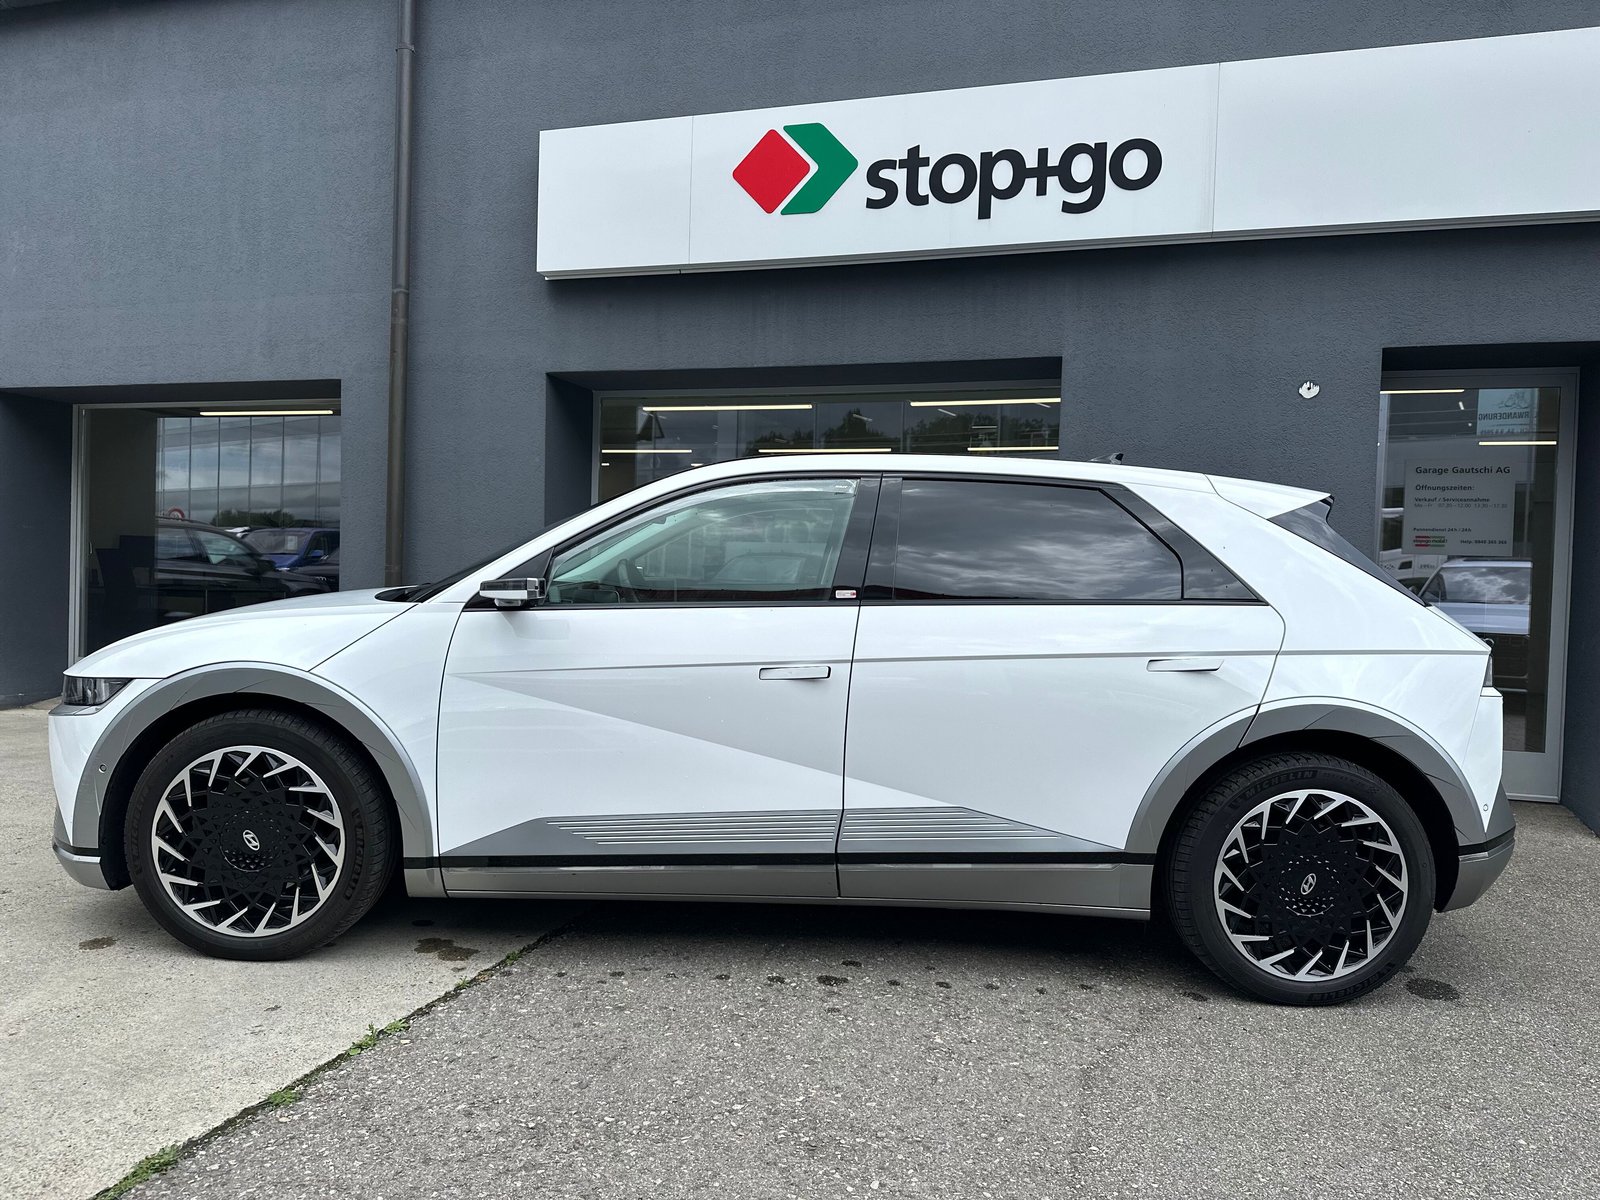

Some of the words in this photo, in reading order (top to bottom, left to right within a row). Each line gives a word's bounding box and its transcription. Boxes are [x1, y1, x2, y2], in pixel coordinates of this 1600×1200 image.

[865, 138, 1162, 219] stop+go
[1415, 466, 1449, 475] Garage
[1451, 465, 1493, 474] Gautschi
[1495, 466, 1511, 474] AG
[1415, 483, 1475, 492] Öffnungszeiten:
[1244, 770, 1314, 800] MICHELIN
[344, 826, 365, 898] MICHELIN
